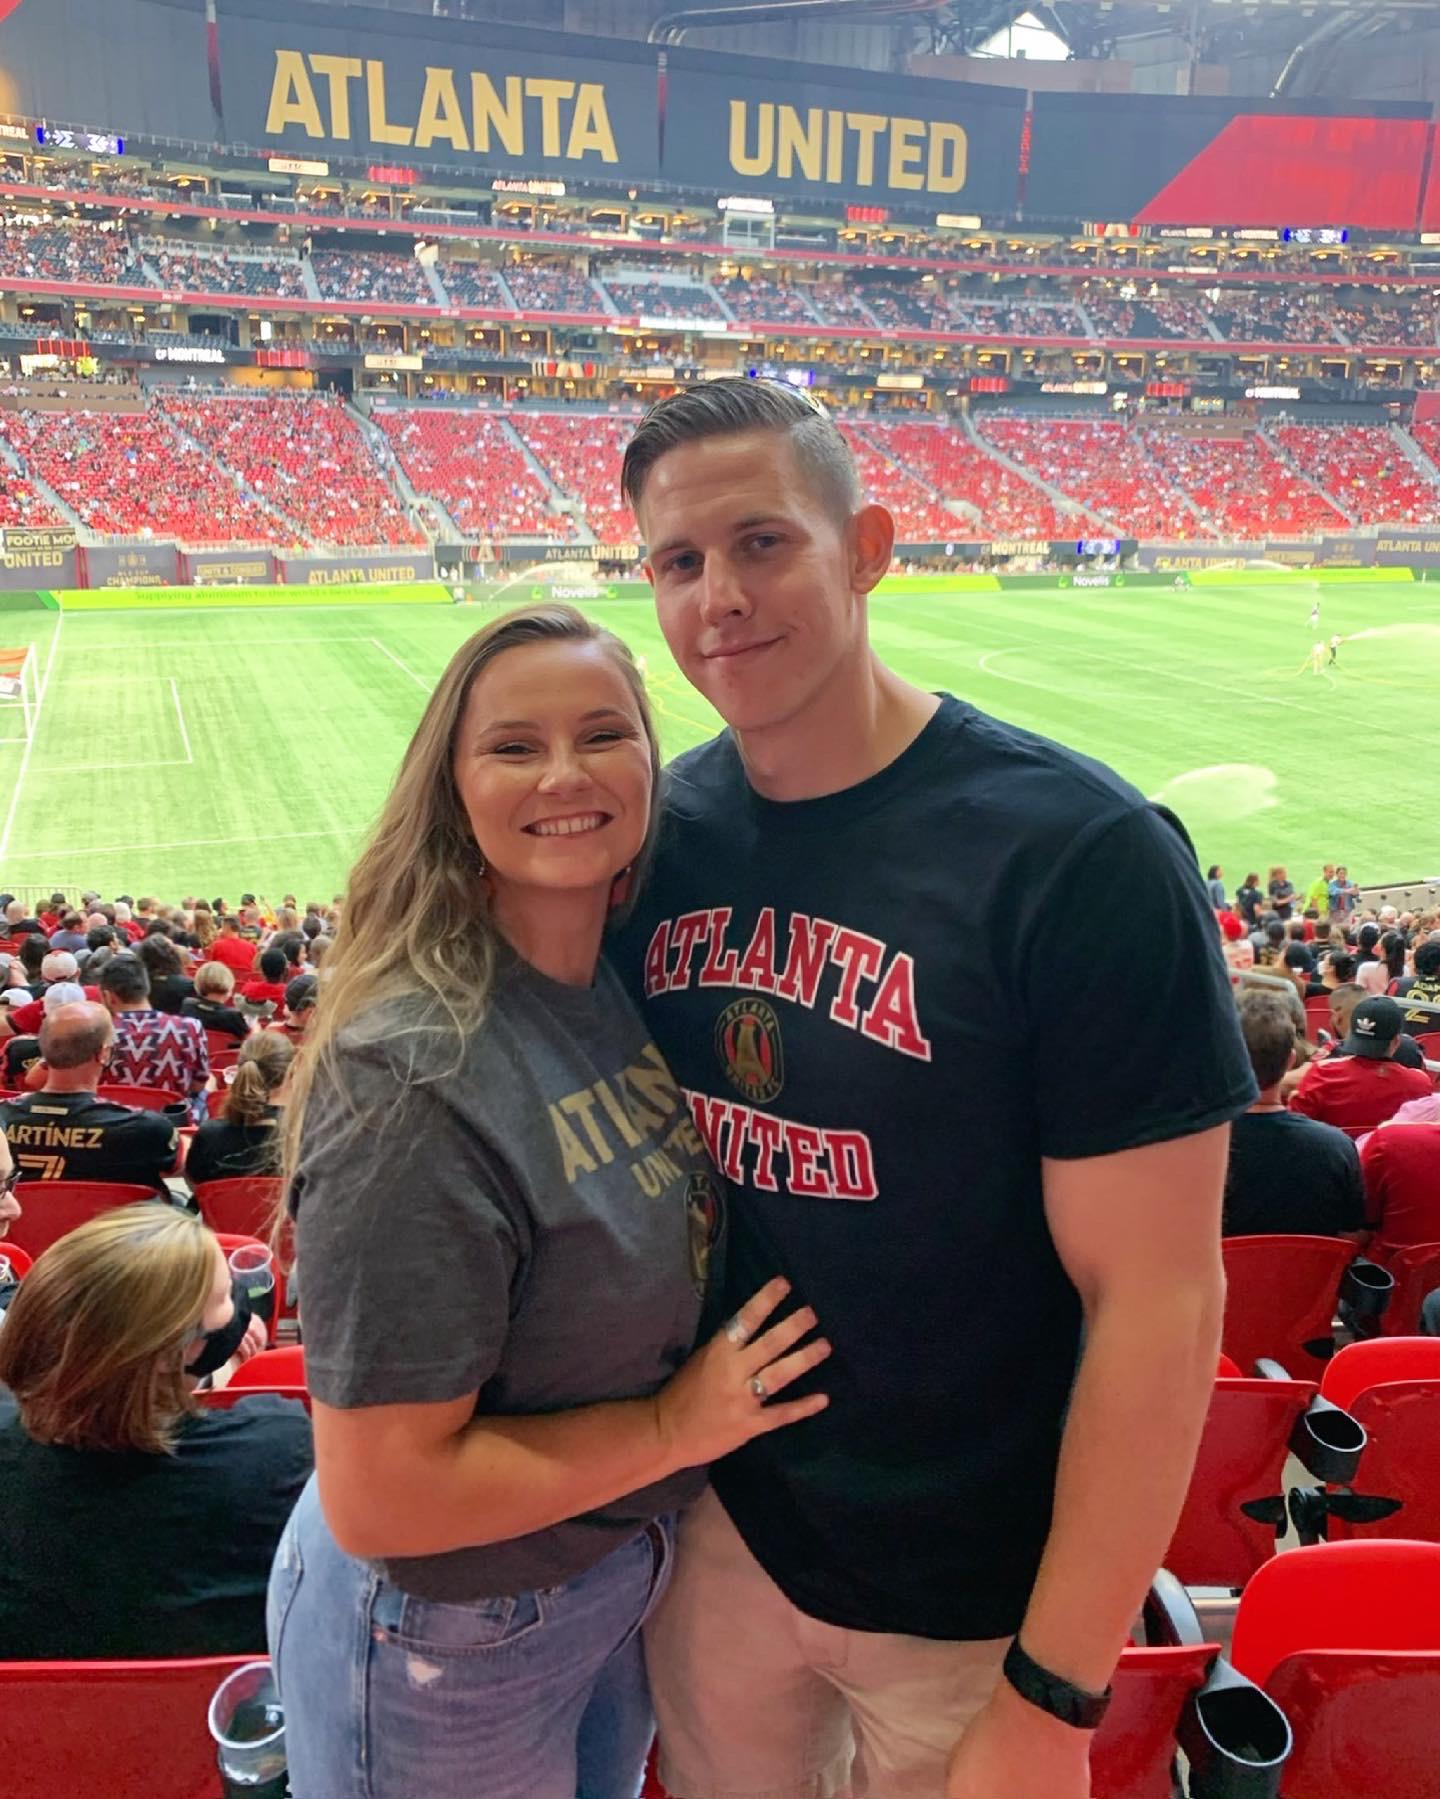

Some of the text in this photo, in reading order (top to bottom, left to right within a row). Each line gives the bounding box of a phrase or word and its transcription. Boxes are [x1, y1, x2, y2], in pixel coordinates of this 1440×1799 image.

[265, 49, 619, 163] ATLANTA
[729, 100, 968, 194] UNITED
[7, 534, 51, 546] FOOTIE
[992, 542, 1051, 556] MONTREAL
[4, 551, 63, 569] UNITED
[545, 544, 640, 560] ATLANTA UNITED
[309, 566, 416, 585] ATLANTA UNITED
[1073, 574, 1111, 588] Novelis
[644, 906, 932, 1062] ATLANTA
[547, 1042, 681, 1184] ATLAN
[6, 1121, 104, 1149] ARTÍNEZ
[680, 1087, 880, 1202] NITED
[17, 1153, 66, 1180] 7
